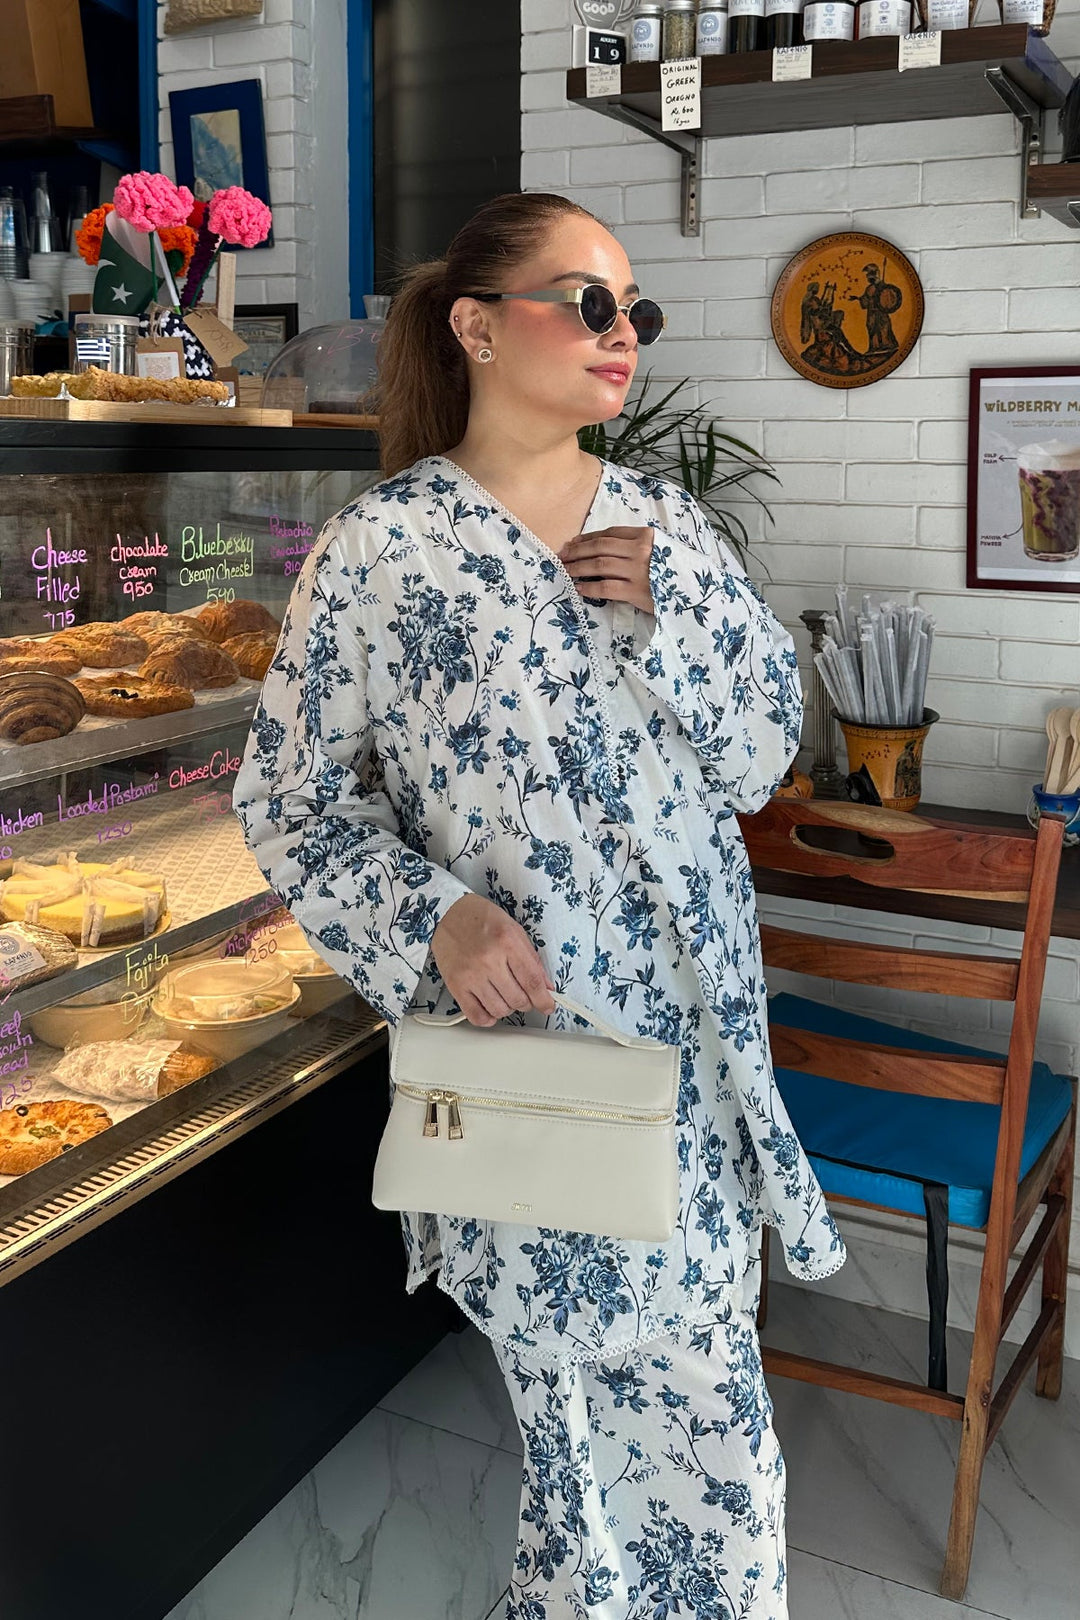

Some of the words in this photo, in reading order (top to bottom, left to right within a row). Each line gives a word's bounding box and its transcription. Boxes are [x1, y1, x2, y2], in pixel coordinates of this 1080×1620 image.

[583, 2, 615, 15] GOOD
[593, 46, 600, 59] 1
[610, 48, 620, 60] 9
[662, 65, 697, 75] ORIGINAL
[667, 77, 695, 88] GREEK
[31, 527, 87, 569] Cheese
[36, 575, 80, 603] Filled
[123, 581, 154, 602] 950
[0, 808, 44, 838] hicken
[125, 943, 169, 990] Fajita
